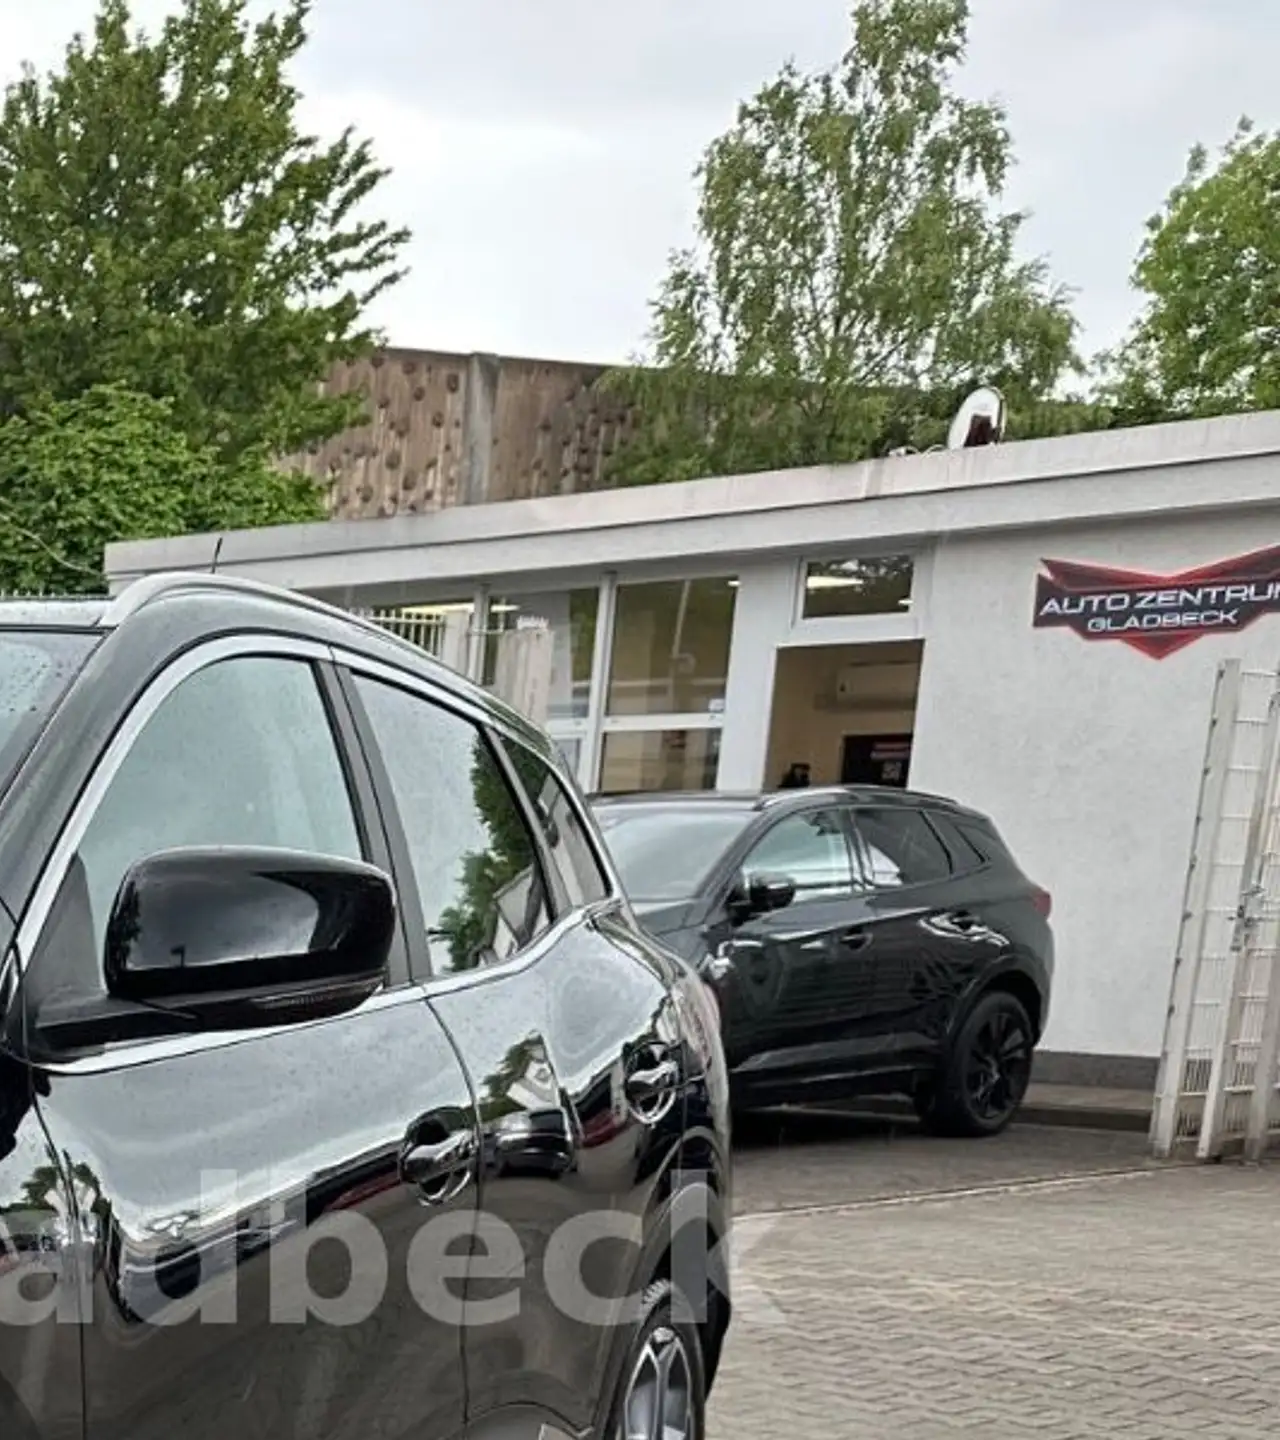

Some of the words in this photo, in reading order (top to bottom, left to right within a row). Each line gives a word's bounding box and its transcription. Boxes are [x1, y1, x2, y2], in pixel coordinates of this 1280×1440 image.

[1040, 592, 1130, 617] AUTO
[1134, 582, 1280, 609] ZENTRU
[1088, 609, 1240, 632] GLADBECK
